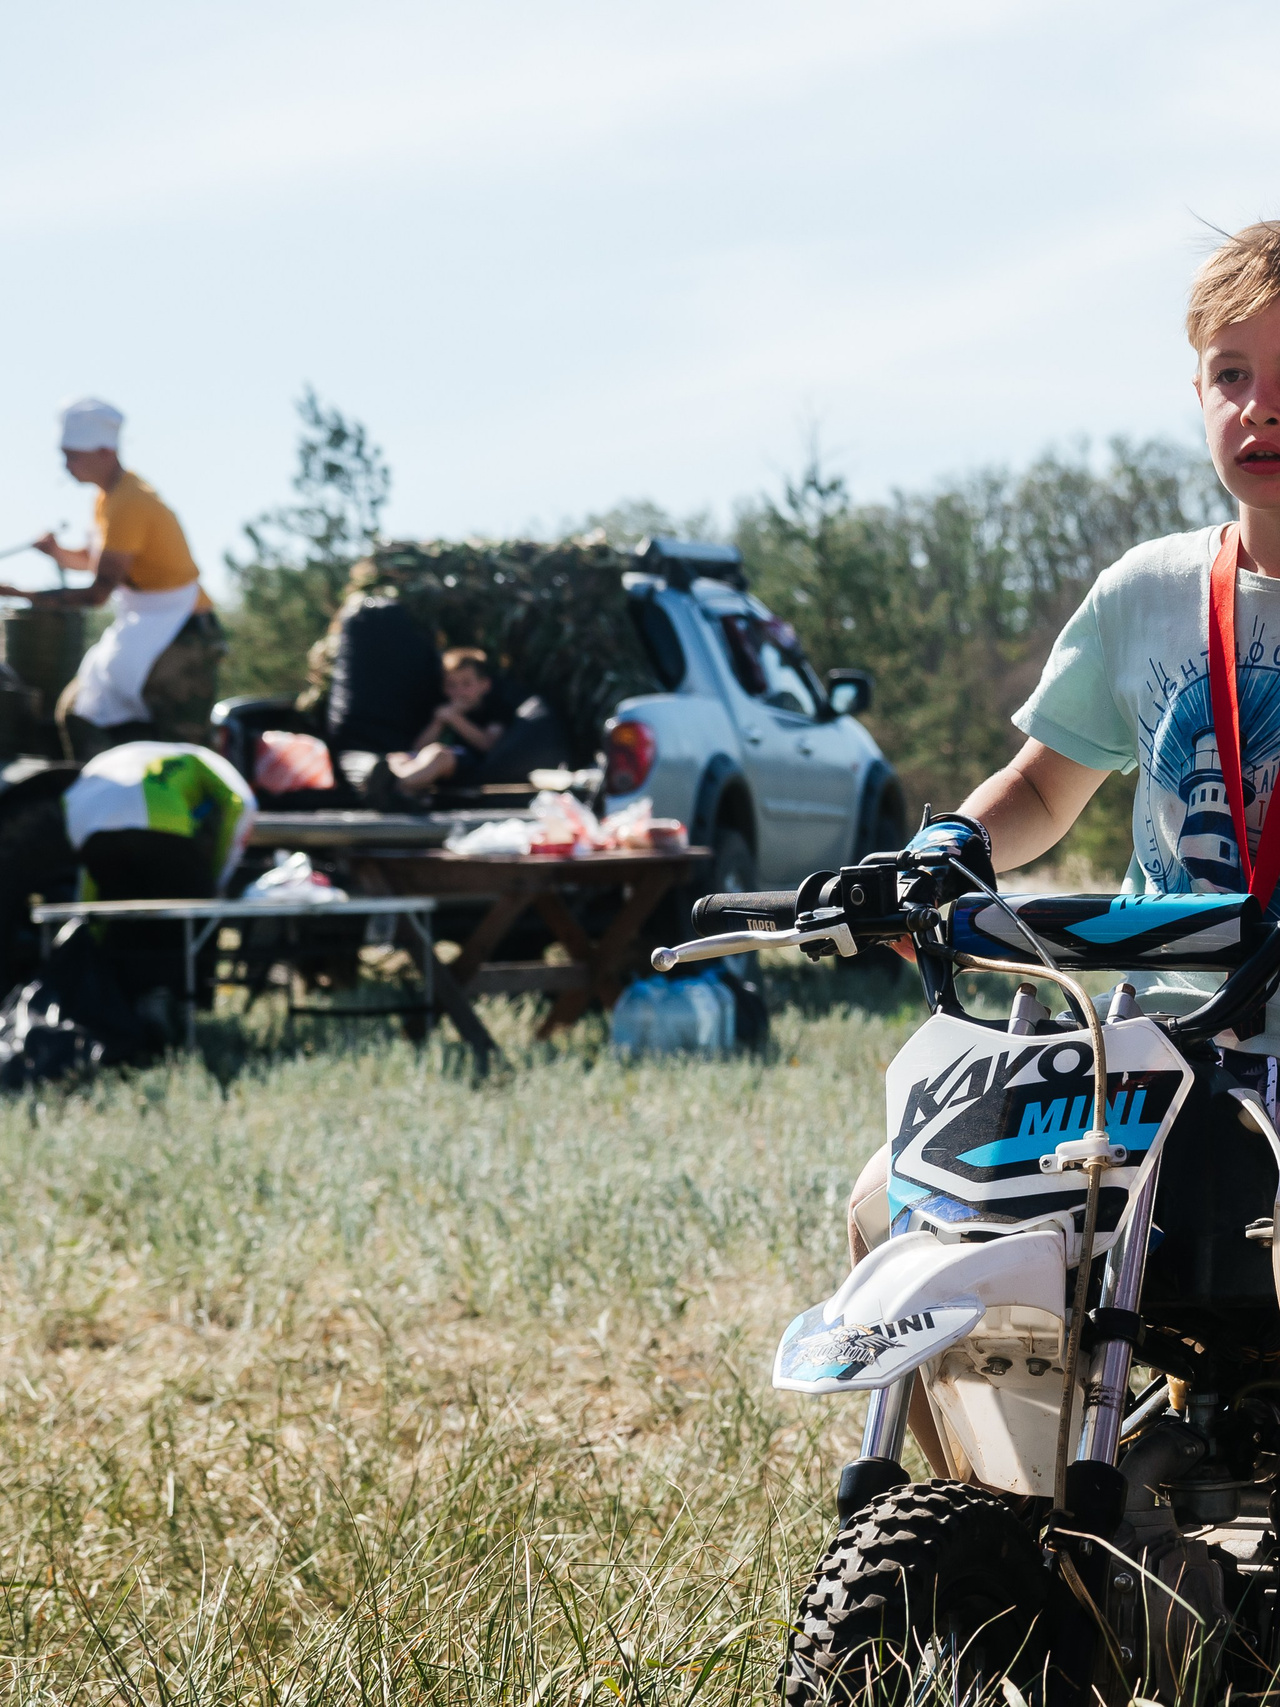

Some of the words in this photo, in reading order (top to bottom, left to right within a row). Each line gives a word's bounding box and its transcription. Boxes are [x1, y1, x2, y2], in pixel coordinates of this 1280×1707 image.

[746, 918, 777, 932] TAPER
[895, 1041, 1095, 1143] KAYO
[1017, 1089, 1147, 1137] MINI
